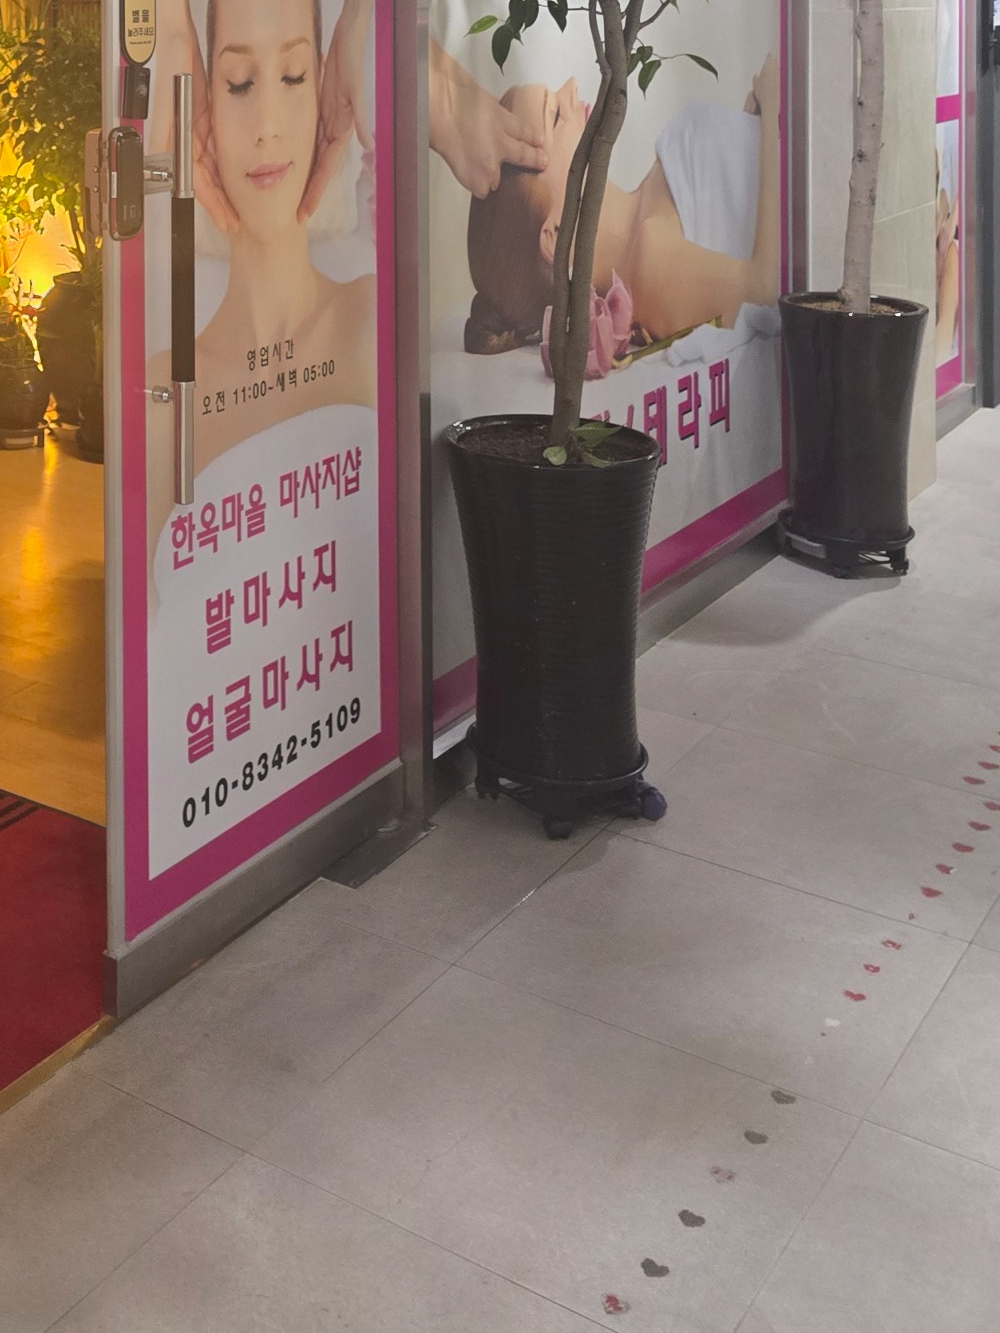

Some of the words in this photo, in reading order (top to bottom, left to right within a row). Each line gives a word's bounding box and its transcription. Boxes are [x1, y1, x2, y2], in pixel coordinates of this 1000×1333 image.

[202, 390, 225, 415] 오전
[303, 359, 335, 384] 05:00
[247, 339, 294, 371] 영업시간
[279, 446, 362, 519] 마사지샵
[185, 620, 354, 765] 얼굴마사지
[181, 696, 361, 828] 010-8342-5109
